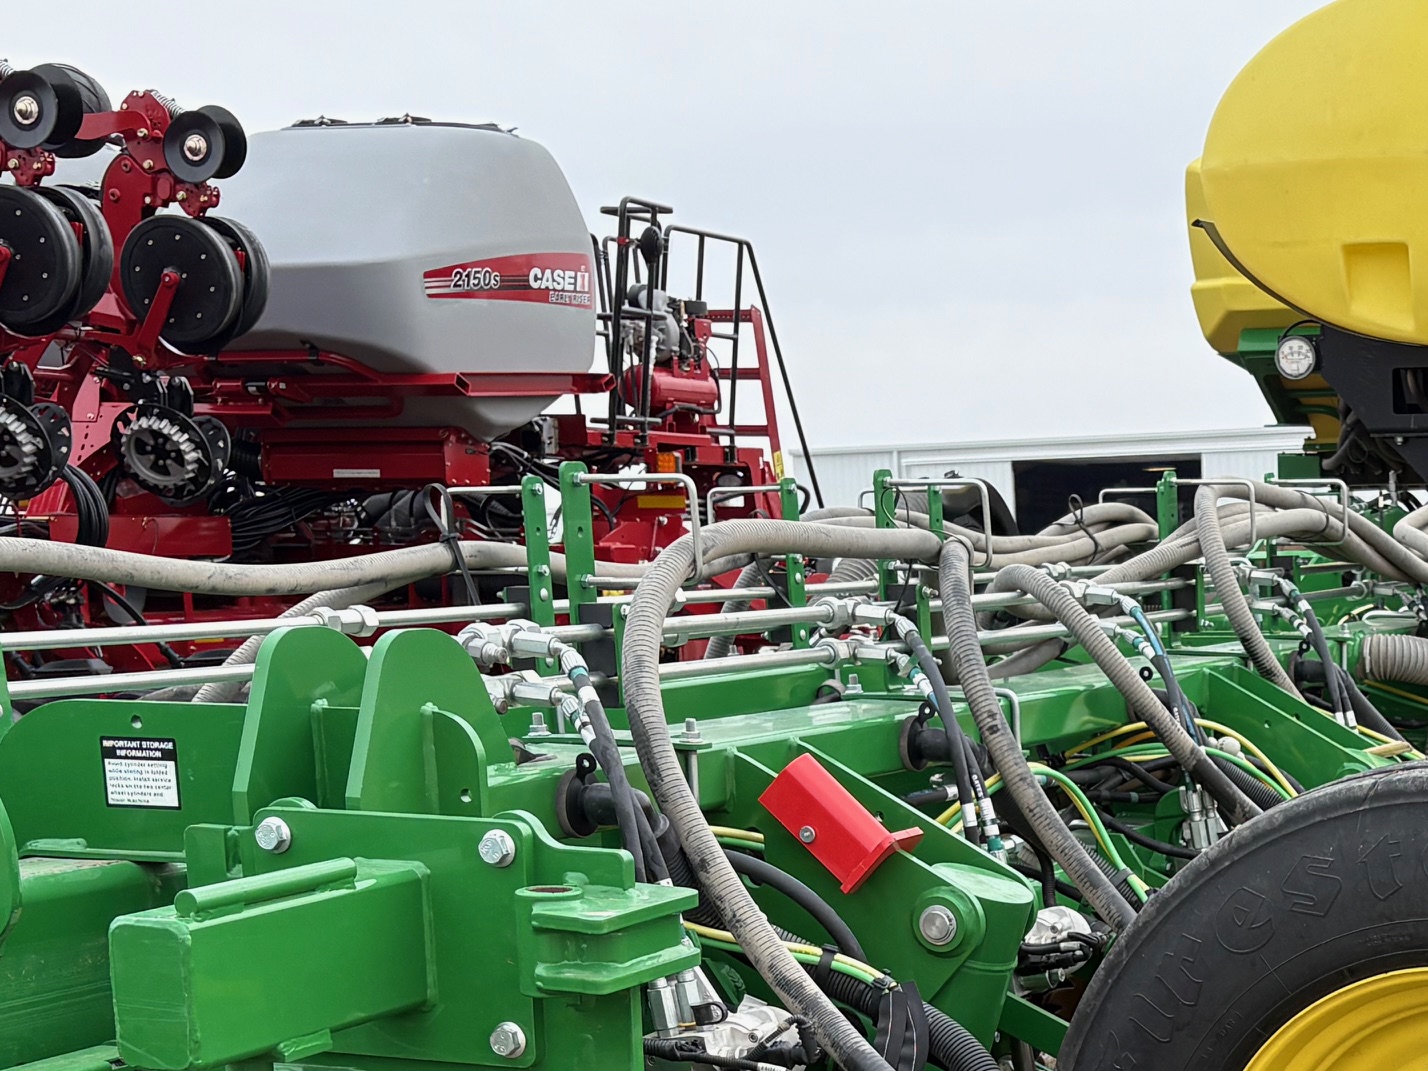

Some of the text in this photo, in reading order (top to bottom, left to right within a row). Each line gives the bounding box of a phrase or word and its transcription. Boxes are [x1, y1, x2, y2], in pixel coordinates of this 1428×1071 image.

[450, 267, 500, 290] 2150s
[528, 267, 575, 291] CASE
[102, 739, 174, 750] IMPORTANT STORAGE
[115, 749, 162, 758] INFORMATION
